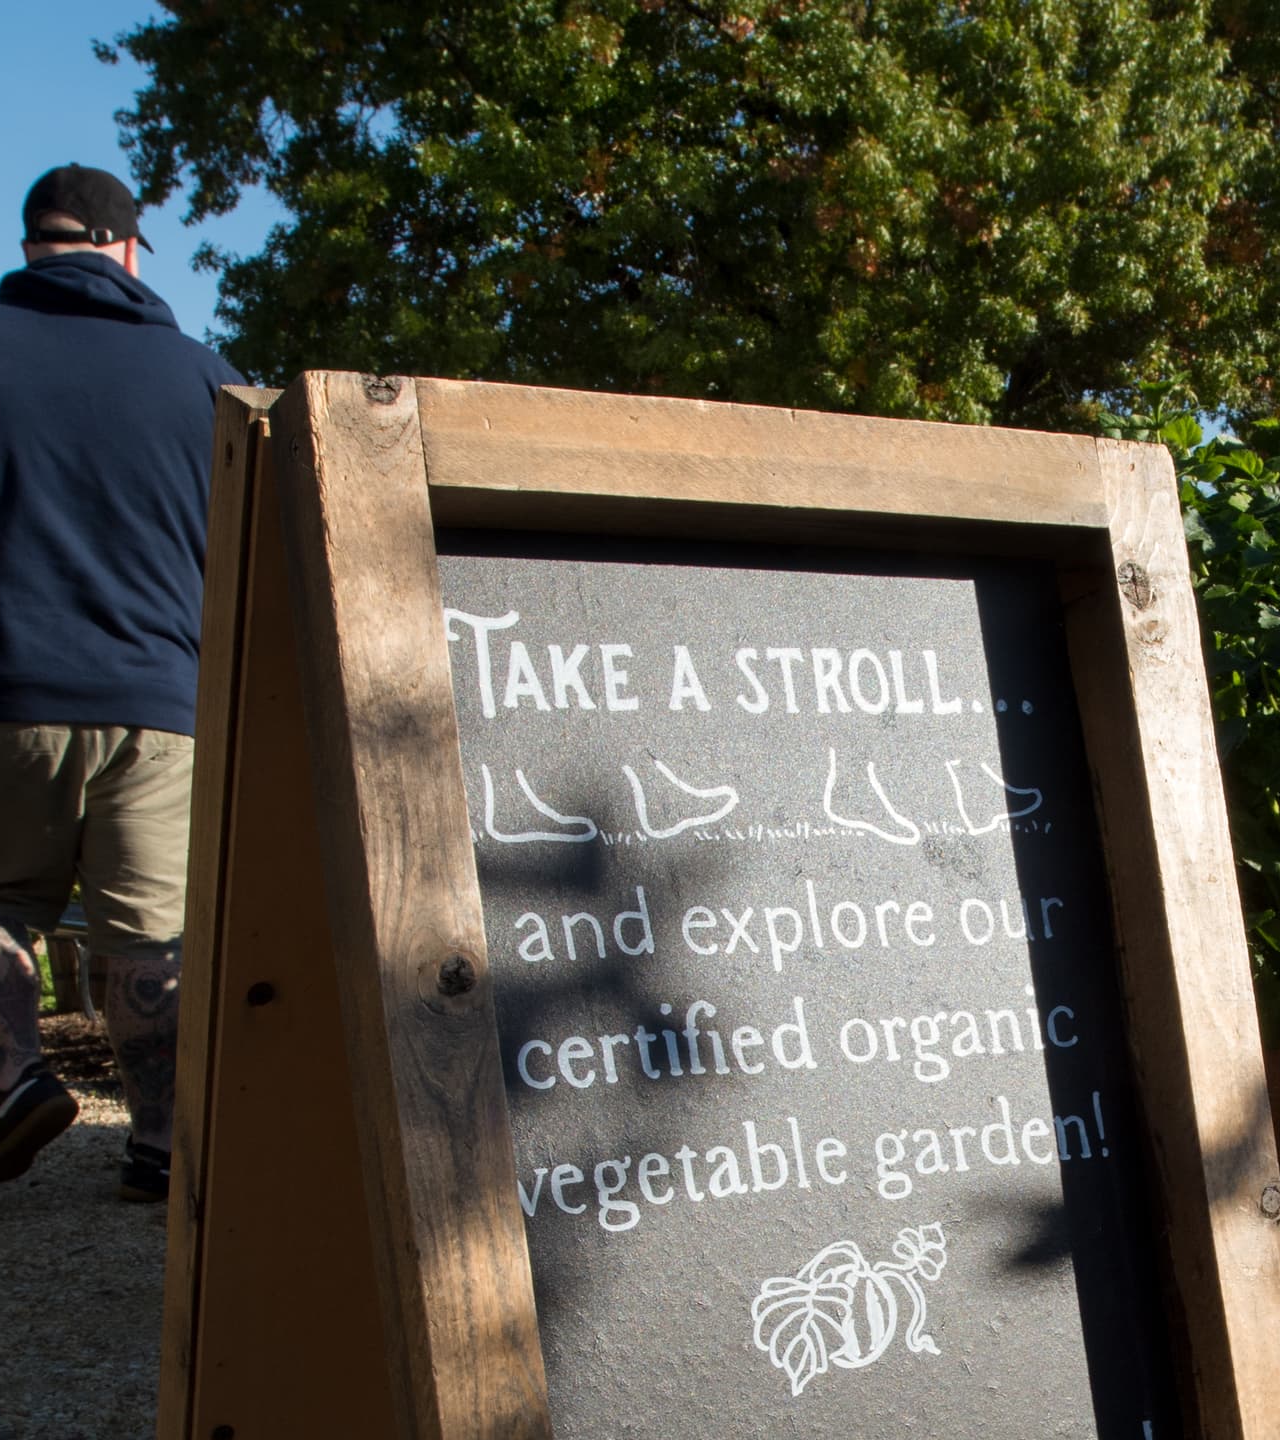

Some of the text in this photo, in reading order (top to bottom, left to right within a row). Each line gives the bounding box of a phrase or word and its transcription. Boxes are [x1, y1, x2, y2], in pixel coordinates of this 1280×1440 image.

[442, 607, 638, 719] TAKE
[669, 644, 712, 713] A
[515, 879, 1064, 972] and explore our
[519, 984, 1079, 1090] certified organic
[517, 1091, 1110, 1232] vegetable garden!
